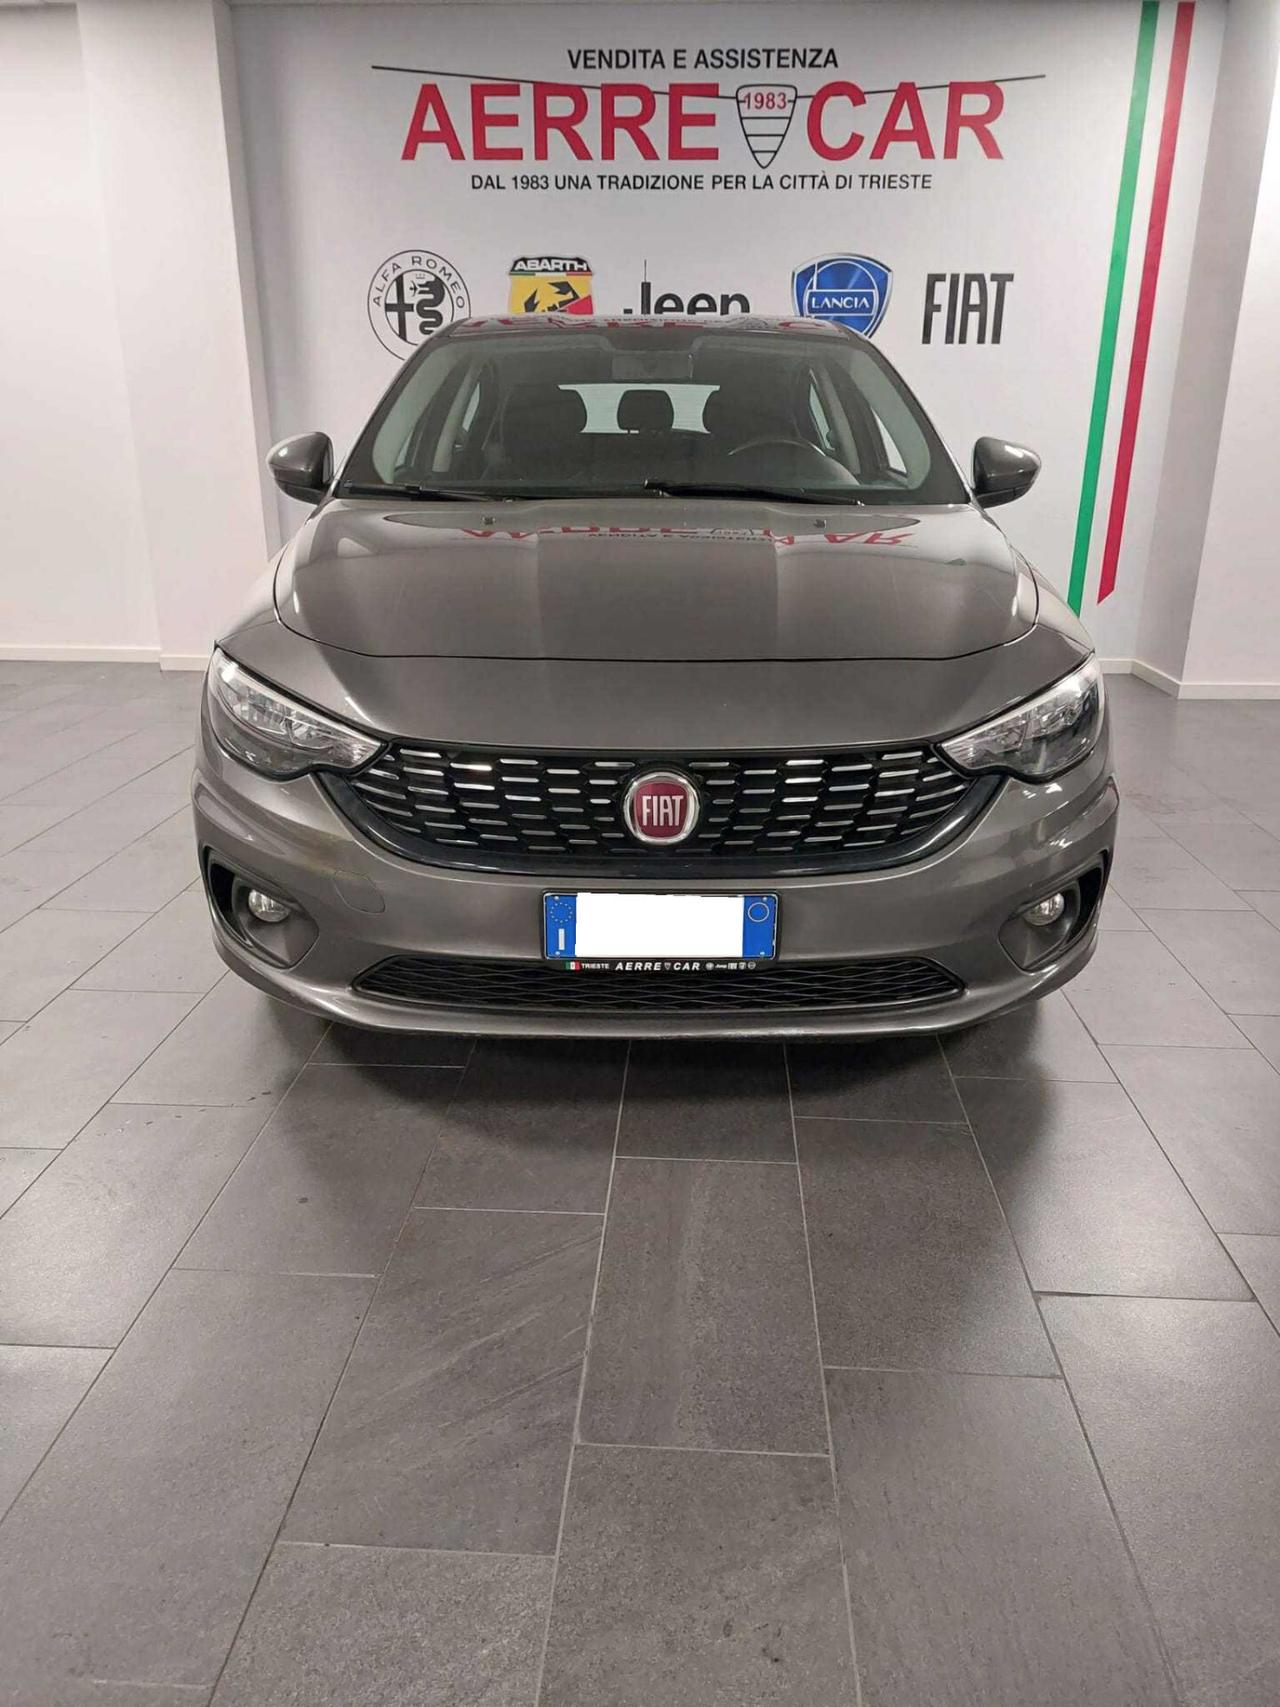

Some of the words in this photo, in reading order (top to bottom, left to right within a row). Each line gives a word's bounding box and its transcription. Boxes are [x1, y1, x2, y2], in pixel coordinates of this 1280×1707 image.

[567, 48, 666, 70] VENDITA
[673, 48, 687, 70] E
[693, 48, 839, 70] ASSISTENZA
[743, 91, 788, 111] 1983
[402, 81, 720, 161] AERRE
[807, 80, 1004, 161] CAR
[472, 175, 506, 190] DAL
[511, 175, 550, 190] 1983
[555, 175, 592, 190] UNA
[597, 175, 704, 190] TRADIZIONE
[712, 175, 747, 190] PER
[753, 175, 774, 190] LA
[779, 171, 830, 190] CITTÀ
[836, 175, 853, 190] DI
[859, 175, 932, 190] TRIESTE
[514, 258, 588, 271] ABARTH
[373, 262, 402, 307] ALFA
[411, 255, 465, 309] ROMEO
[812, 297, 869, 309] LANCIA
[922, 273, 1014, 345] FIAT
[641, 795, 684, 826] FIAT
[581, 962, 610, 970] TRIESTE
[615, 962, 662, 971] AERRE
[673, 962, 700, 971] CAR
